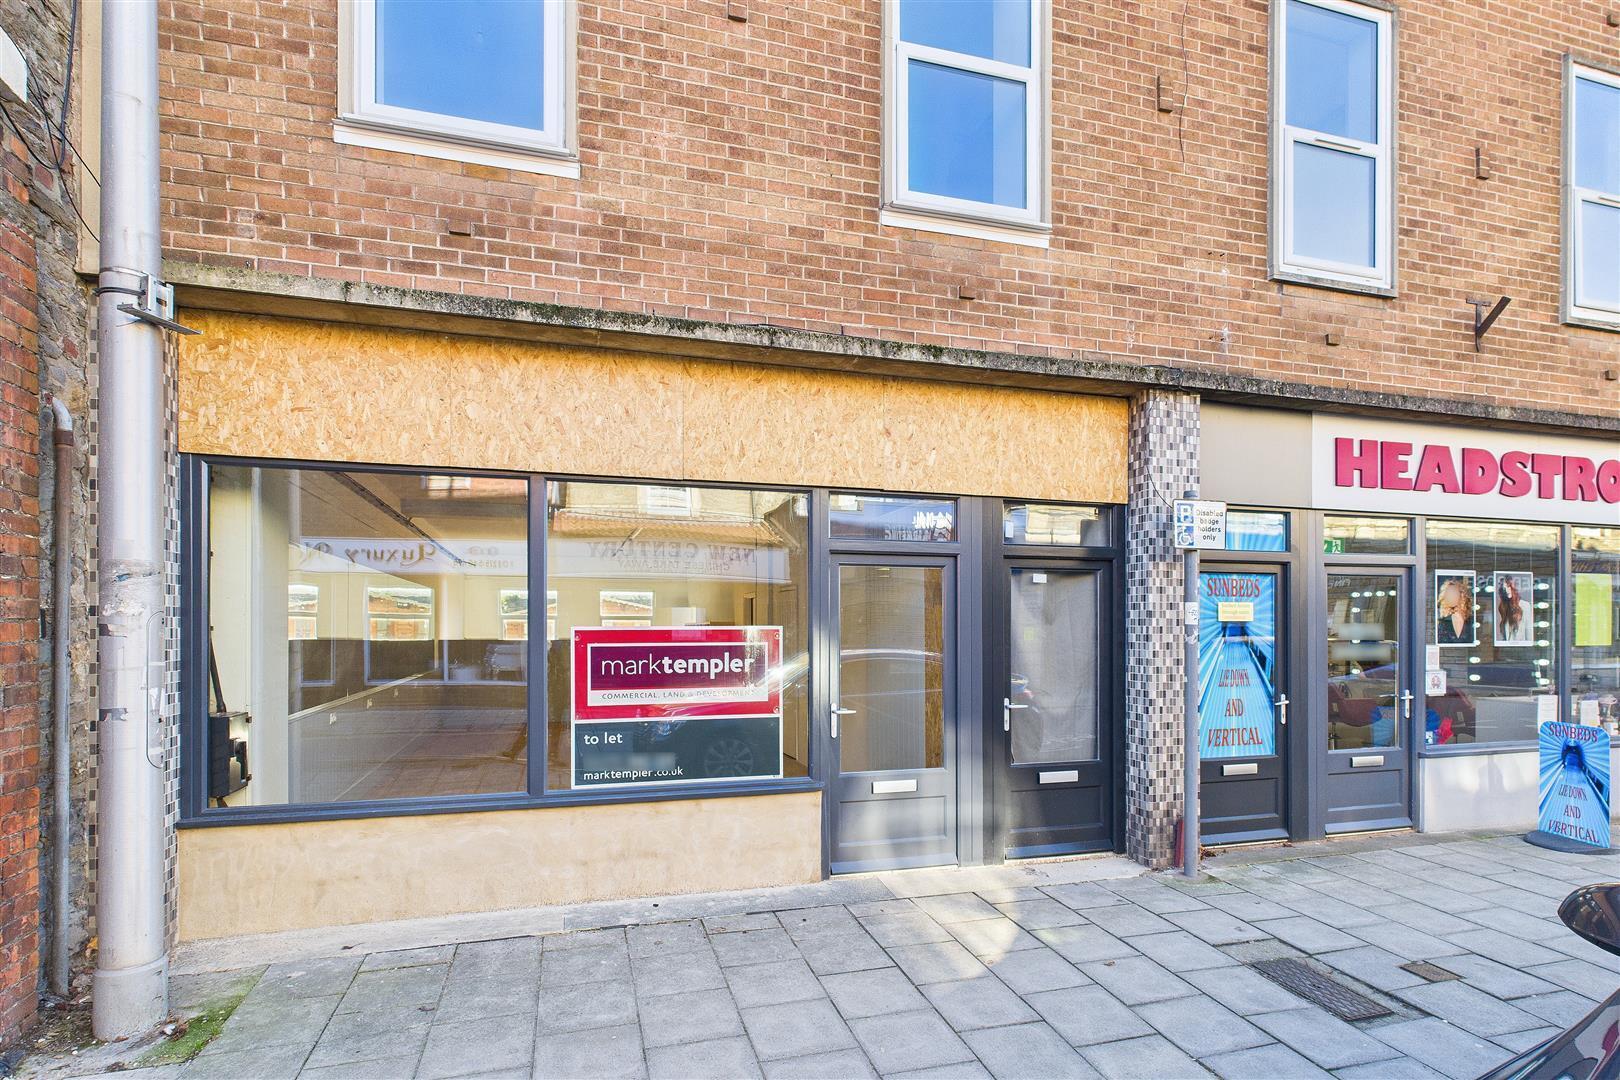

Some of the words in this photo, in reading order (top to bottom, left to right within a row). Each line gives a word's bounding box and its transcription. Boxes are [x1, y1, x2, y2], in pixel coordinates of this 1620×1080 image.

[1335, 437, 1620, 504] HEADSTRO
[1207, 578, 1261, 598] SUNBEDS
[1218, 669, 1229, 687] LIE
[1230, 668, 1251, 687] DOWN
[602, 691, 660, 700] COMMERCIAL,
[663, 690, 684, 699] LAND
[1224, 699, 1244, 717] AND
[583, 733, 599, 745] to
[604, 732, 623, 744] let
[1207, 726, 1263, 748] VERTICAL
[1548, 723, 1598, 742] SUNBEDS
[1559, 783, 1568, 797] LIE
[1568, 785, 1588, 801] DOWN
[1563, 804, 1581, 819] AND
[1548, 819, 1600, 844] VERTICAL
